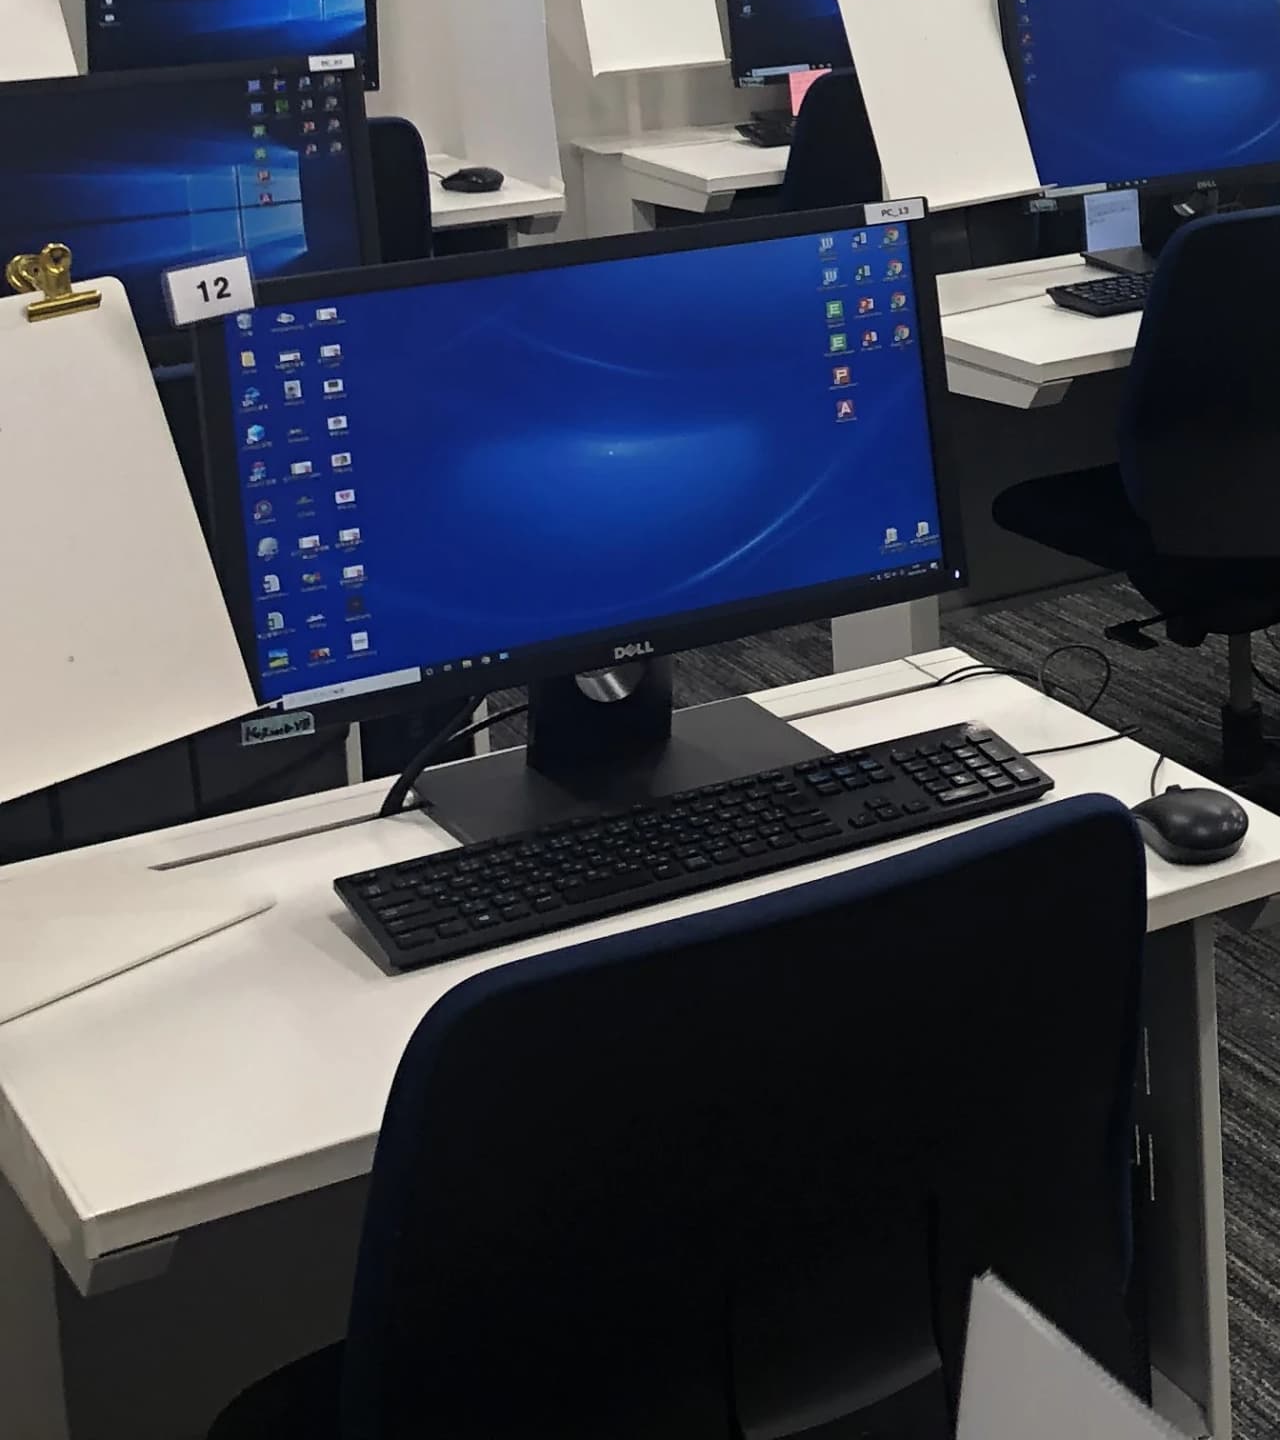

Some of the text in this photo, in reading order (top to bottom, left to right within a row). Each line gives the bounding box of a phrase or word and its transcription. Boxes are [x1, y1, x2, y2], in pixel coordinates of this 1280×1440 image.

[880, 206, 910, 218] PC_13
[196, 276, 232, 302] 12
[614, 641, 655, 660] DELL
